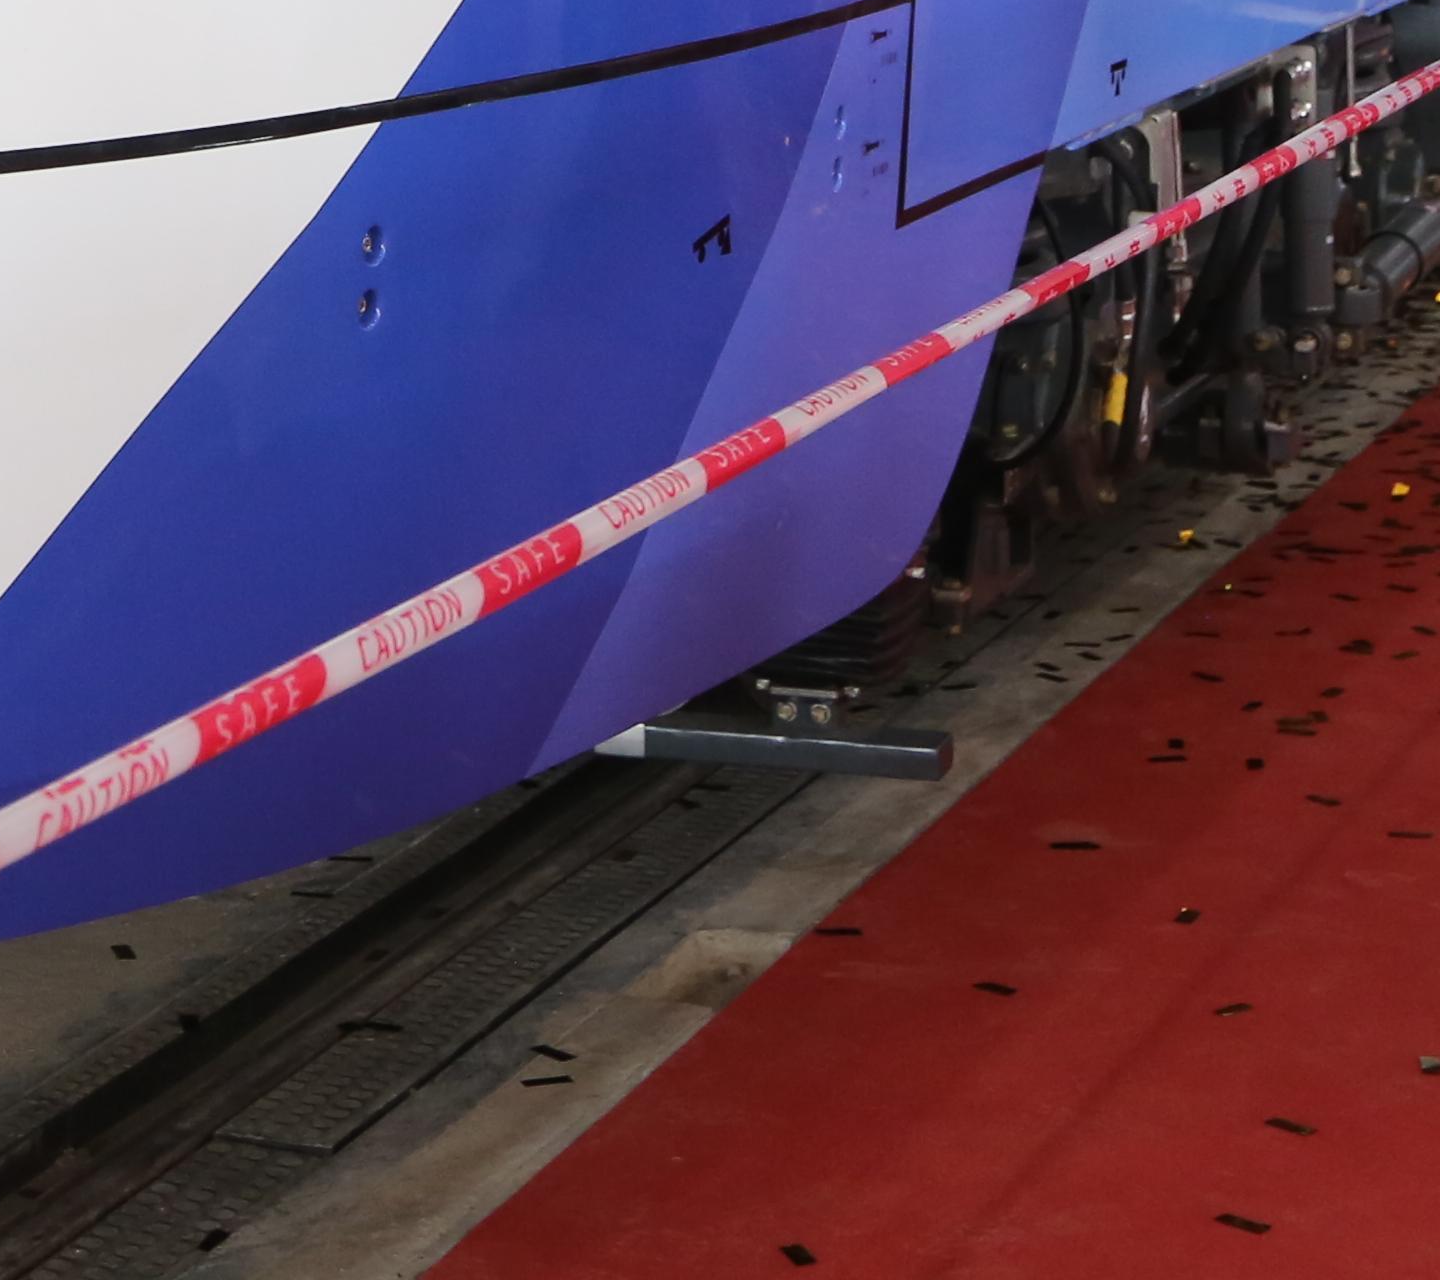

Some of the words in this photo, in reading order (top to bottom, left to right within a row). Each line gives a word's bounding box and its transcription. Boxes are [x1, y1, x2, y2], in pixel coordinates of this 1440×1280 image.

[215, 672, 301, 748] SAFE
[357, 587, 463, 673] CAUTION
[489, 532, 566, 595] SAFE
[598, 467, 691, 529] CAUTION
[705, 424, 772, 468] SAFE
